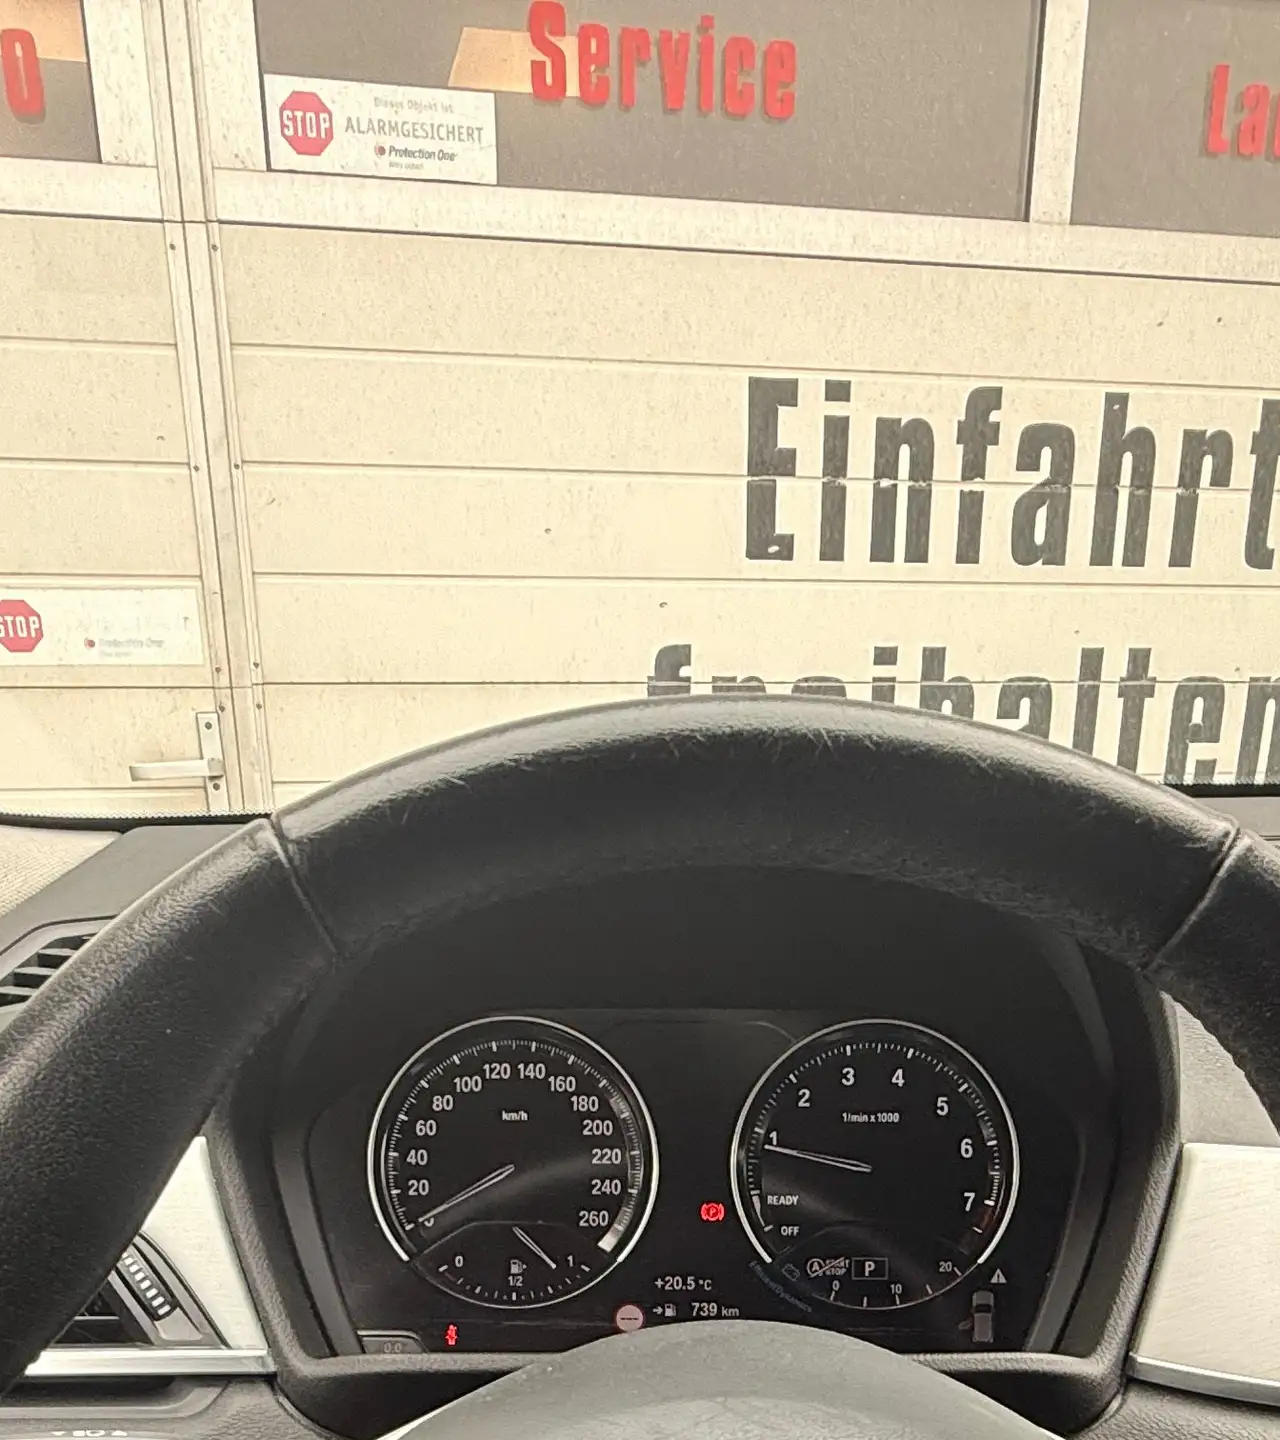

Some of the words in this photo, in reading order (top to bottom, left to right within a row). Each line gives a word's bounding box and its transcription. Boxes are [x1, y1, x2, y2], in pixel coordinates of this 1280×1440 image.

[528, 0, 798, 120] Service
[282, 109, 331, 140] STOP
[345, 116, 484, 145] ALARMGESICHERT
[388, 145, 436, 161] Protection
[482, 1063, 511, 1080] 120
[517, 1063, 546, 1080] 140
[841, 1067, 855, 1086] 3
[891, 1068, 905, 1087] 4
[453, 1075, 482, 1093] 100
[548, 1075, 576, 1092] 160
[432, 1095, 454, 1111] 80
[570, 1095, 599, 1112] 180
[797, 1088, 811, 1108] 2
[936, 1097, 949, 1116] 5
[502, 1109, 528, 1122] km/h
[842, 1112, 869, 1123] 1/min
[877, 1112, 900, 1123] 1000
[415, 1119, 437, 1136] 60
[582, 1119, 613, 1136] 200
[769, 1131, 778, 1146] 1
[591, 1148, 622, 1165] 220
[960, 1138, 973, 1158] 6
[406, 1149, 428, 1166] 40
[408, 1179, 429, 1196] 20
[591, 1179, 621, 1195] 240
[767, 1195, 799, 1206] READY
[963, 1192, 975, 1212] 7
[579, 1210, 609, 1227] 260
[780, 1225, 800, 1237] OFF
[454, 1255, 464, 1269] 0
[567, 1255, 574, 1268] 1
[864, 1261, 875, 1277] P
[939, 1261, 952, 1273] 20
[508, 1275, 523, 1288] 1/2
[654, 1276, 695, 1291] +20.5
[832, 1280, 840, 1291] 0
[890, 1282, 902, 1295] 10
[691, 1302, 717, 1317] 739
[721, 1306, 739, 1317] km
